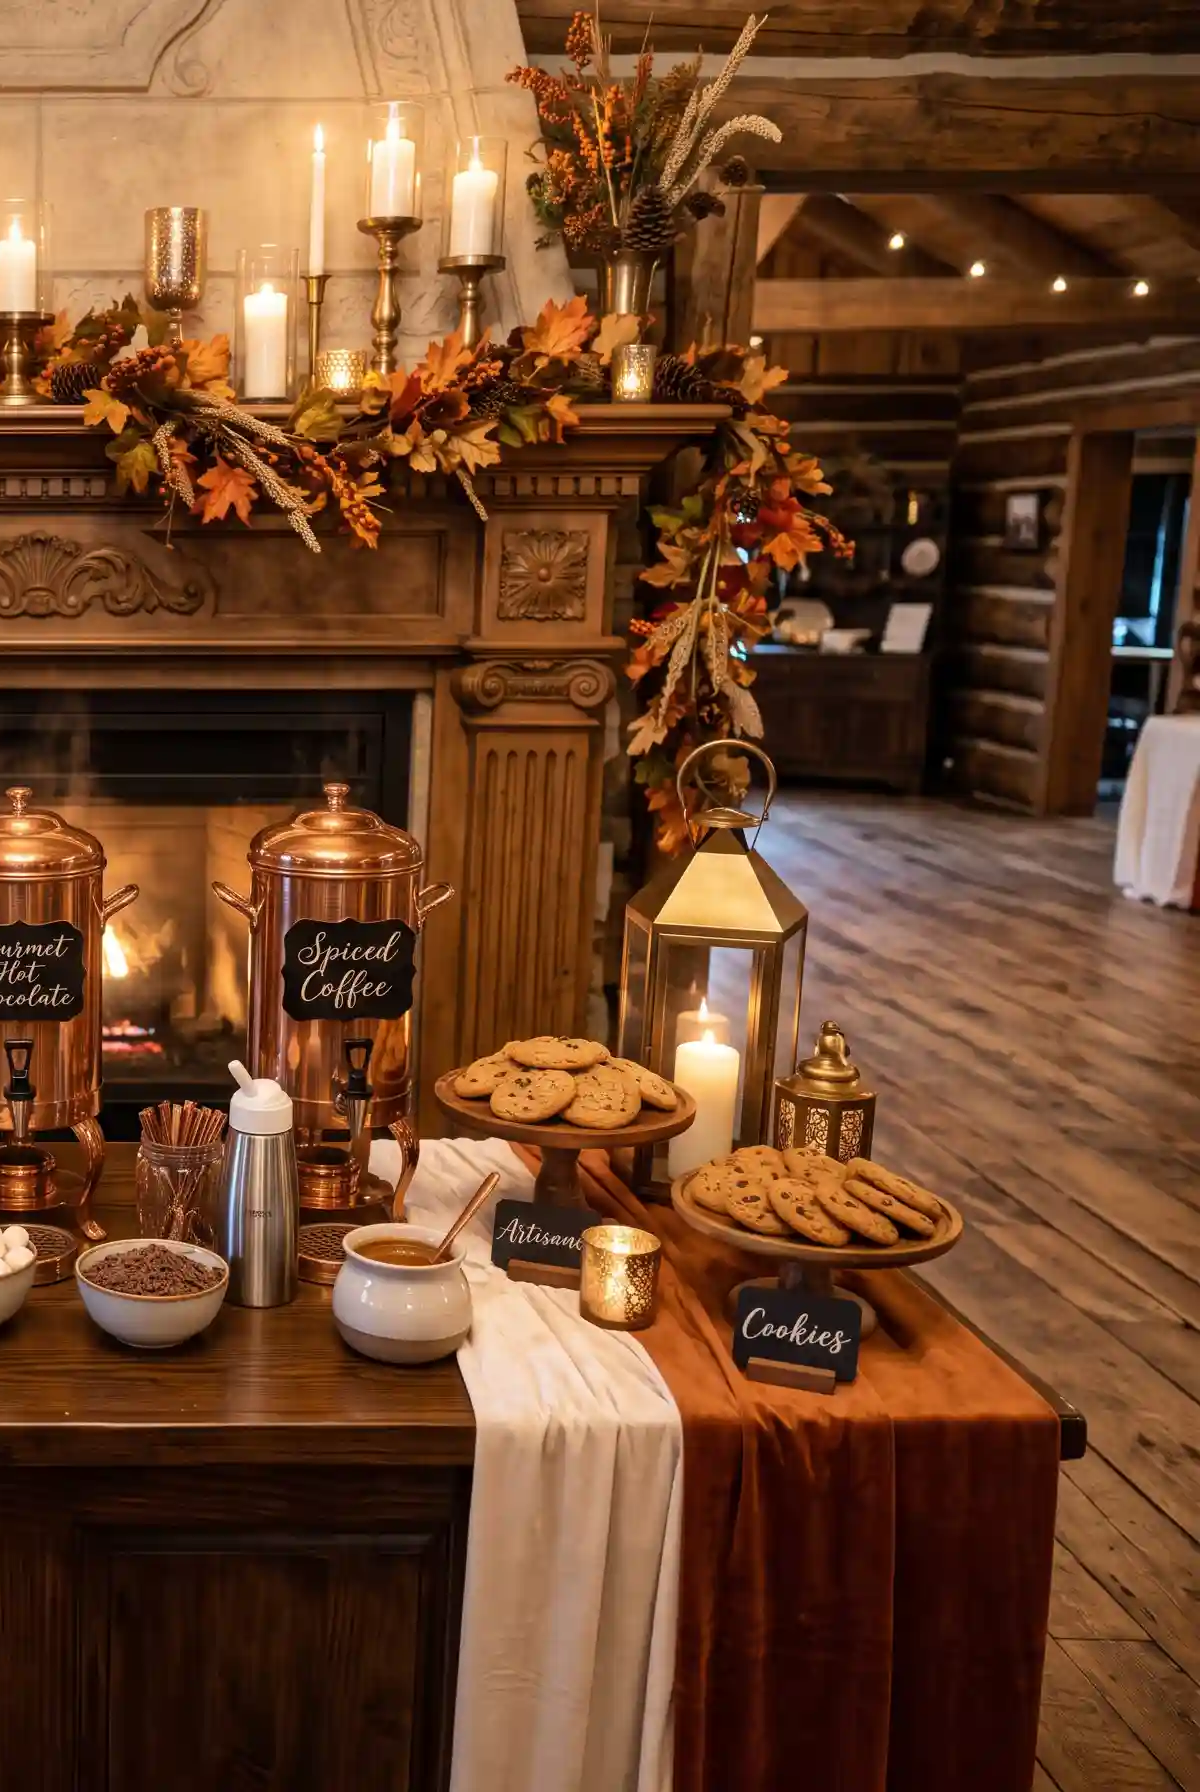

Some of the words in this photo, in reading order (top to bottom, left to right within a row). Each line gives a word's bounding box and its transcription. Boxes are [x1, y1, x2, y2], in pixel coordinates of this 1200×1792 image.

[298, 931, 401, 977] Spiced
[301, 969, 393, 1009] Coffee
[742, 1307, 852, 1354] Cookies
